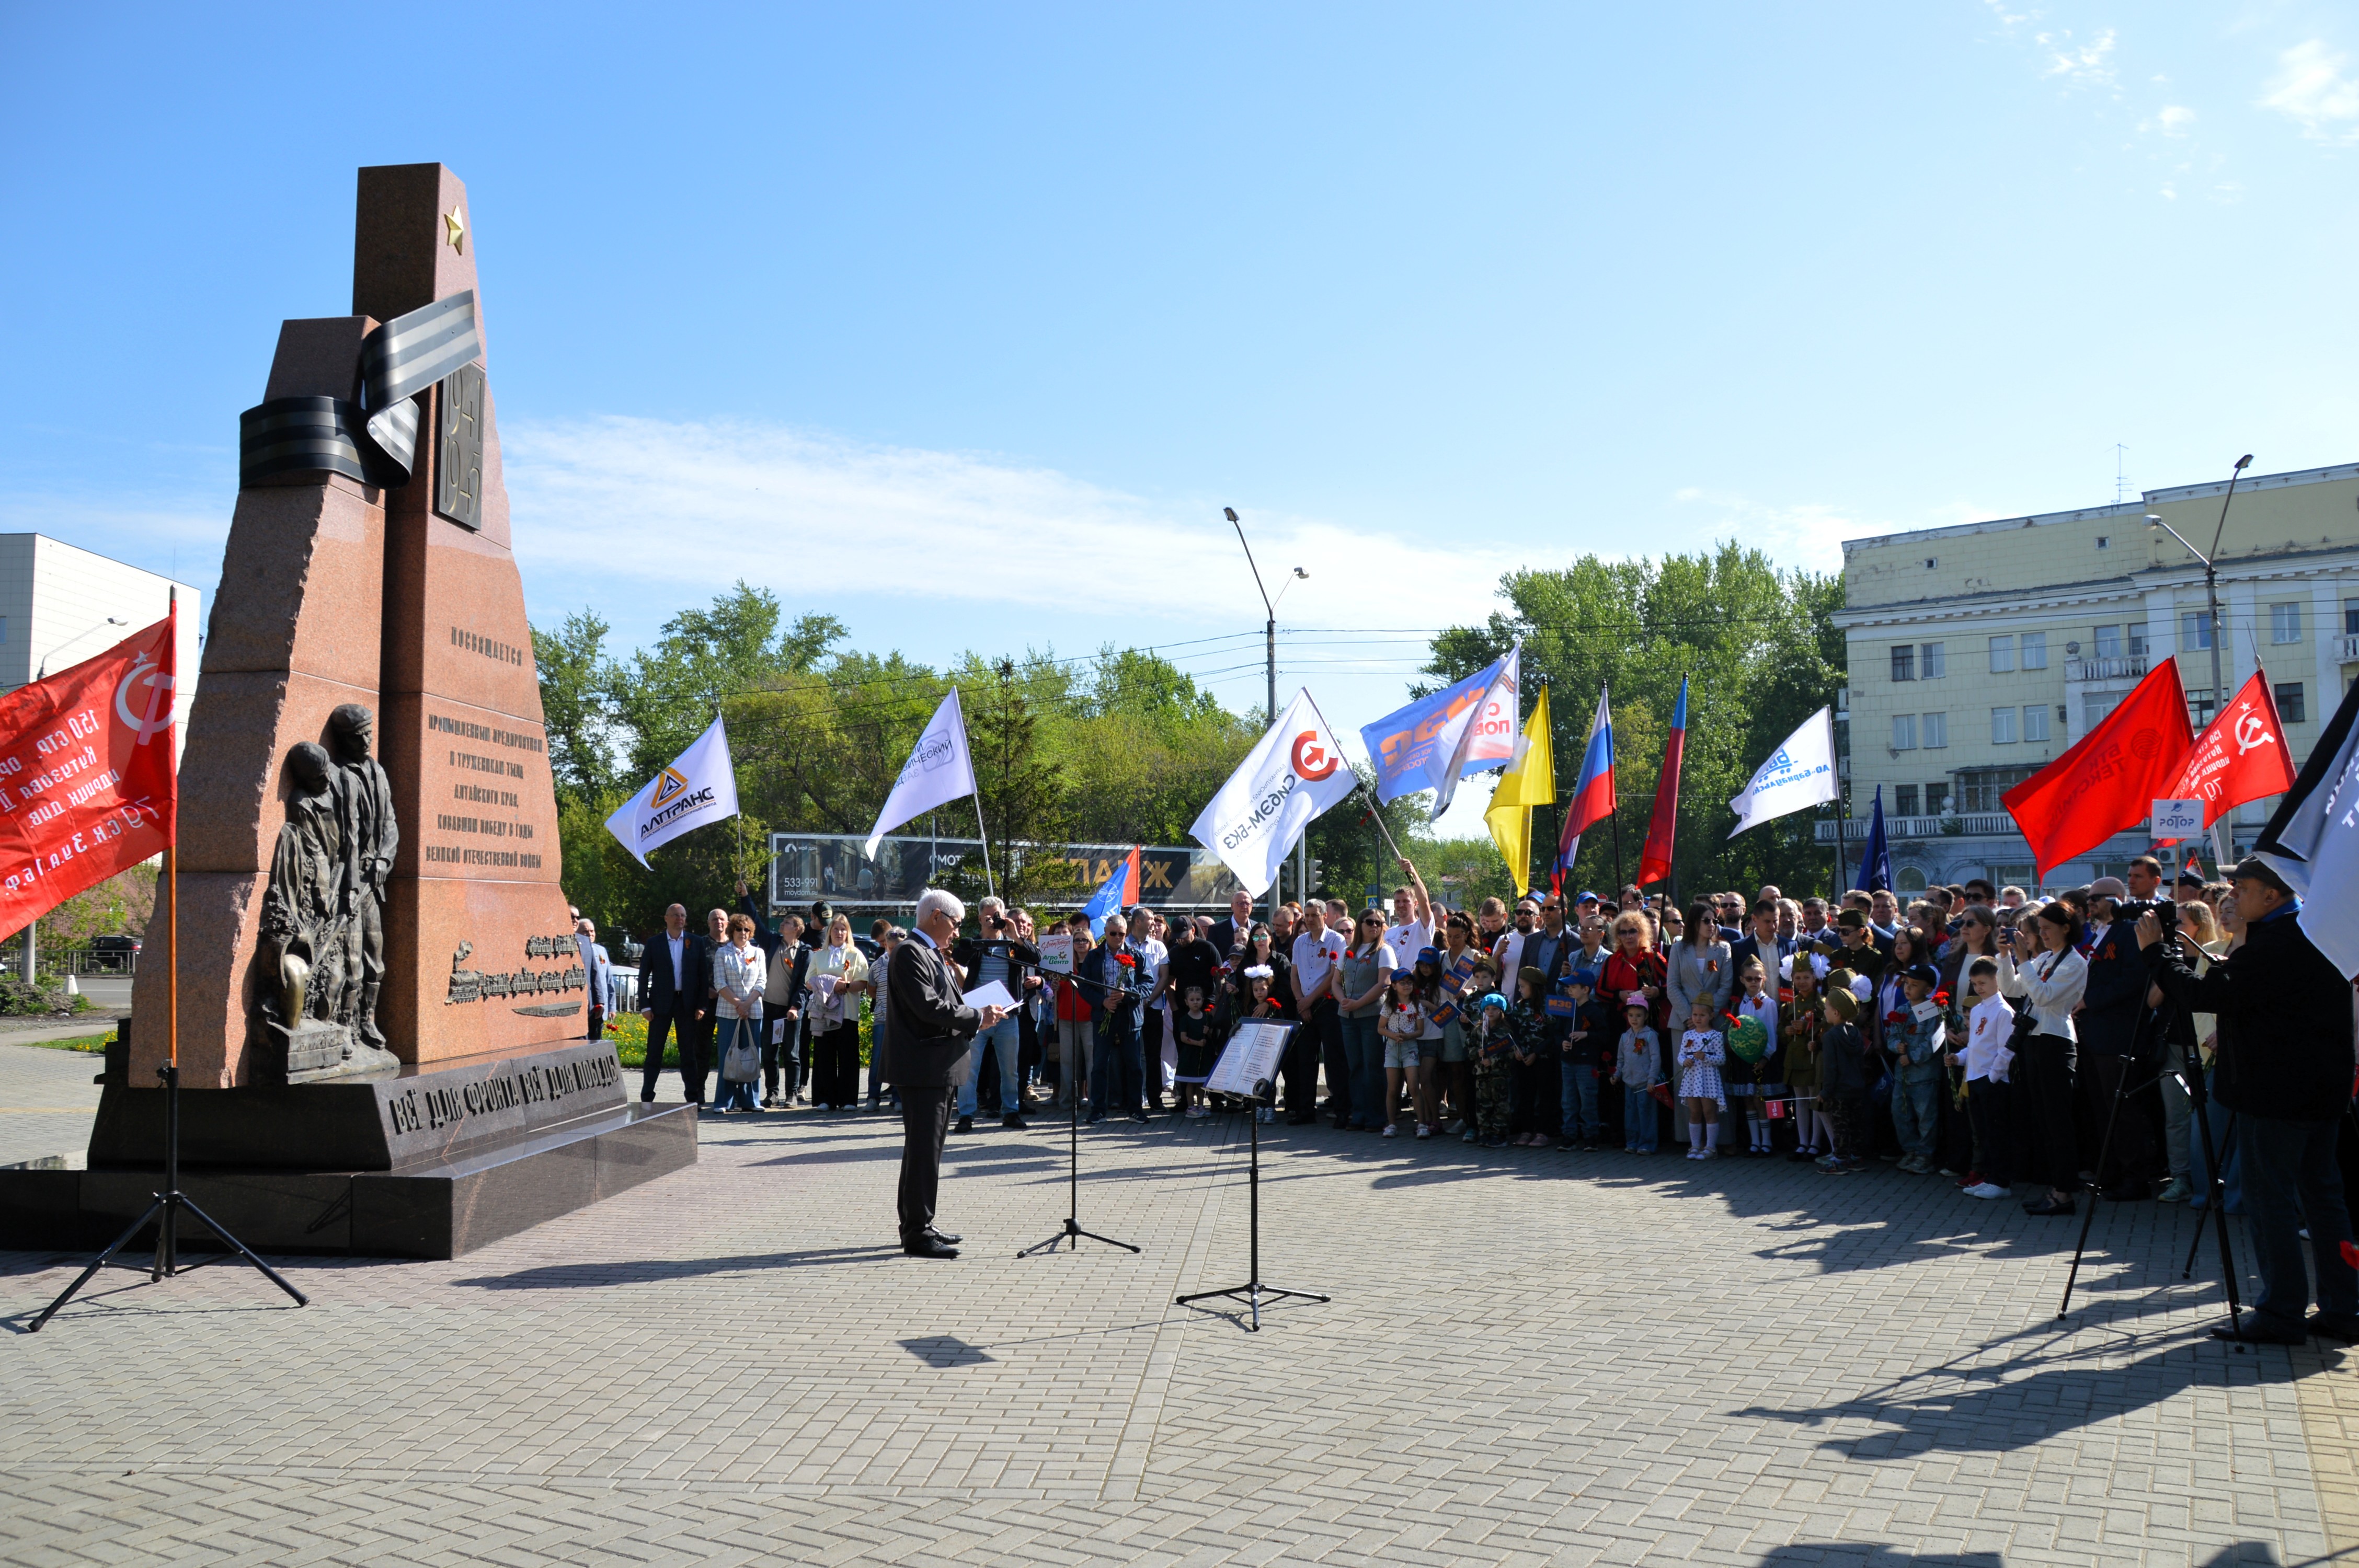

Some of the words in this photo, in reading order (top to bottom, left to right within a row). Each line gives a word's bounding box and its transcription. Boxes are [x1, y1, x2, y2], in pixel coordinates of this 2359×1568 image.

[447, 369, 482, 443] 1941
[443, 436, 481, 523] 1945
[451, 626, 522, 667] ПОСВЯЩАЕТСЯ
[429, 713, 490, 742] ПРОМЫШЛЕННЫМ
[493, 729, 543, 753] ПРЕДПРИЯТИЯМ
[450, 751, 454, 766] И
[457, 752, 504, 775] ТРУЖЕНИКАМ
[506, 762, 523, 779] ТЫЛА
[454, 783, 498, 805] АЛТАЙСКОГО
[501, 791, 519, 809] КРАЯ,
[438, 814, 477, 833] КОВАВШИМ
[480, 819, 507, 837] ПОБЕДУ
[509, 823, 513, 837] В
[516, 823, 533, 839] ГОДЫ
[640, 787, 715, 838] АЛТТРАНС
[426, 846, 460, 863] ВЕЛИКОЙ
[463, 849, 518, 867] ОТЕЧЕСТВЕННОЙ
[520, 853, 541, 869] ВОЙНЫ
[784, 878, 818, 887] 533-991
[784, 889, 818, 897] moydom.su
[1549, 999, 1572, 1009] МЭС
[390, 1089, 425, 1135] ВСЁ
[426, 1087, 463, 1130] ДЛЯ
[464, 1076, 520, 1116] ФРОНТА
[519, 1065, 545, 1104] ВСЁ
[546, 1066, 575, 1101] ДЛЯ
[573, 1055, 619, 1091] ПОБЕДЫ
